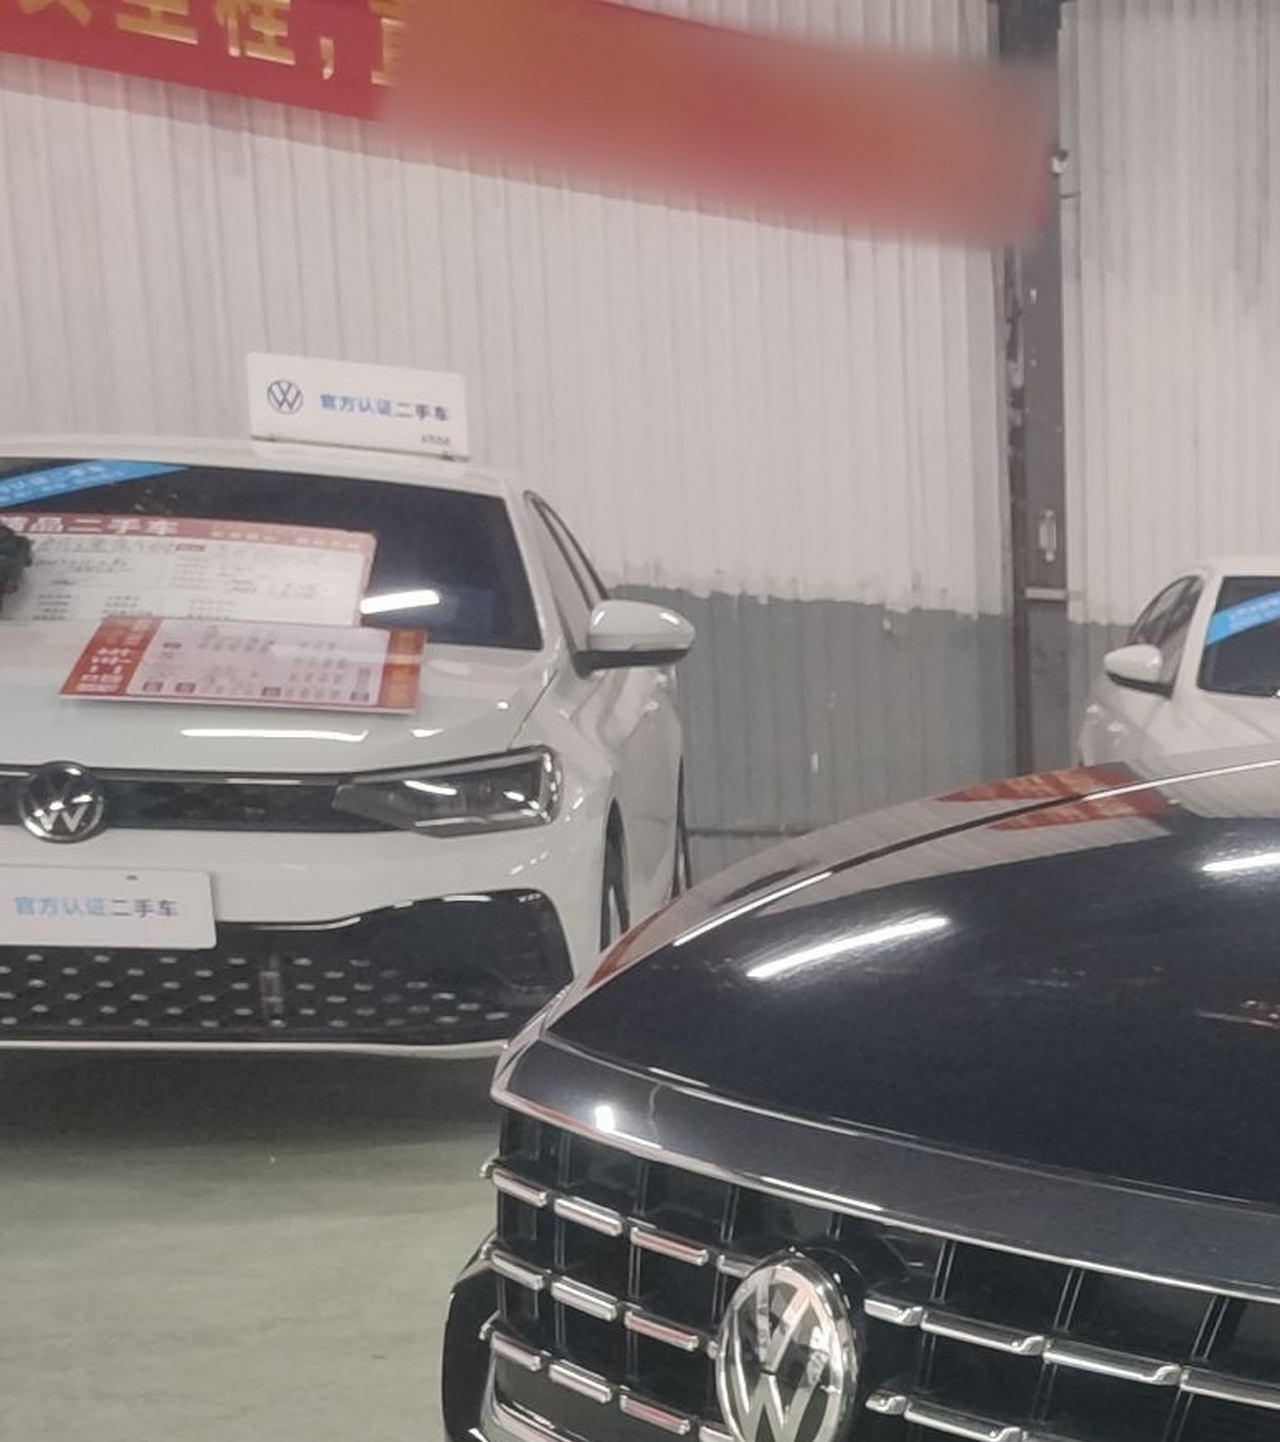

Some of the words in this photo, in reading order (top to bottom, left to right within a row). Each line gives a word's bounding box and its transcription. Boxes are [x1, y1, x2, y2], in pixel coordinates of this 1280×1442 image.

[319, 394, 450, 422] 官方认证二手车
[13, 896, 179, 918] 官方认证二手车
